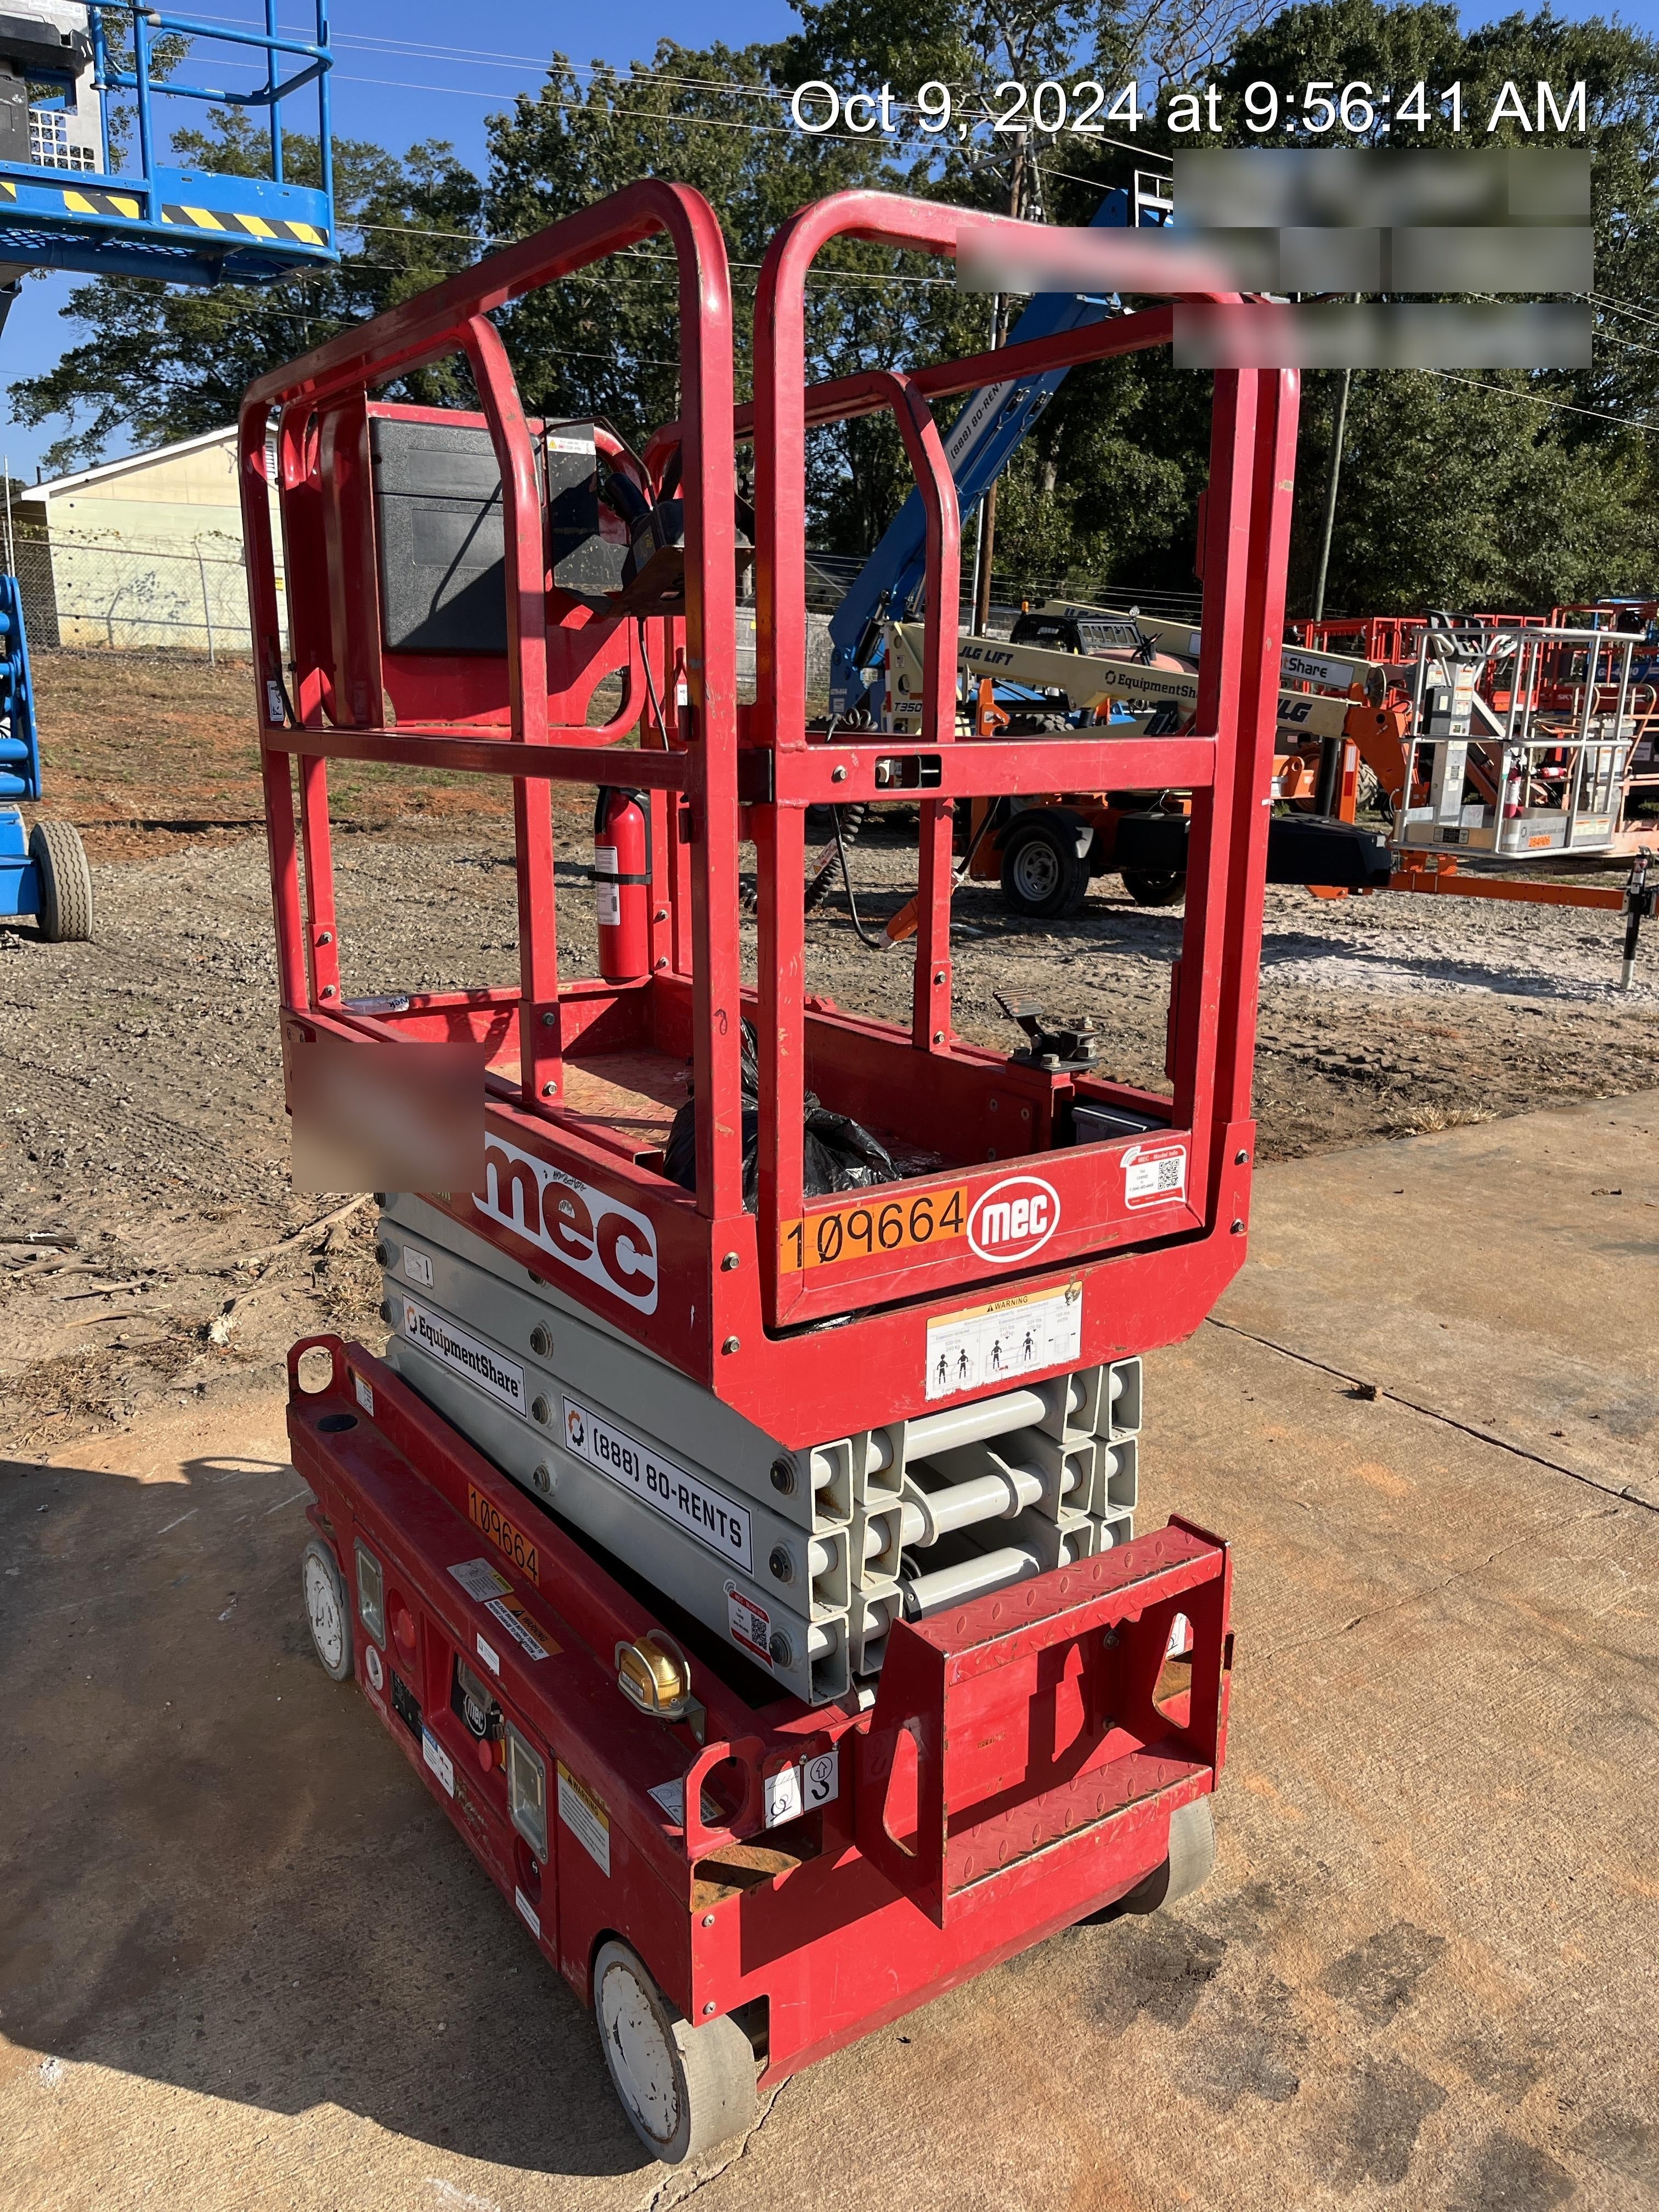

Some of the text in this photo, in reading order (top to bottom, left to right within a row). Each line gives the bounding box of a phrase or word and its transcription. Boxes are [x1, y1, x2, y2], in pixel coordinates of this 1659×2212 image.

[950, 425, 972, 459] (888)
[958, 646, 1014, 666] JLG LIFT
[894, 702, 923, 713] T350
[981, 1194, 1048, 1246] mec
[995, 1295, 1029, 1310] WARNING
[419, 1314, 519, 1398] EquipmentShare
[594, 1427, 742, 1549] (888) 80-RENTS
[487, 1602, 502, 1617] PREVENT
[498, 1614, 512, 1628] DAMAGE
[746, 1601, 757, 1613] Model
[493, 1601, 507, 1615] RELEASE
[505, 1612, 517, 1626] BRAKES
[516, 1623, 529, 1638] BEFORE
[528, 1635, 540, 1650] TOWING
[522, 1616, 549, 1643] WARNING
[573, 1781, 599, 1817] WARNING
